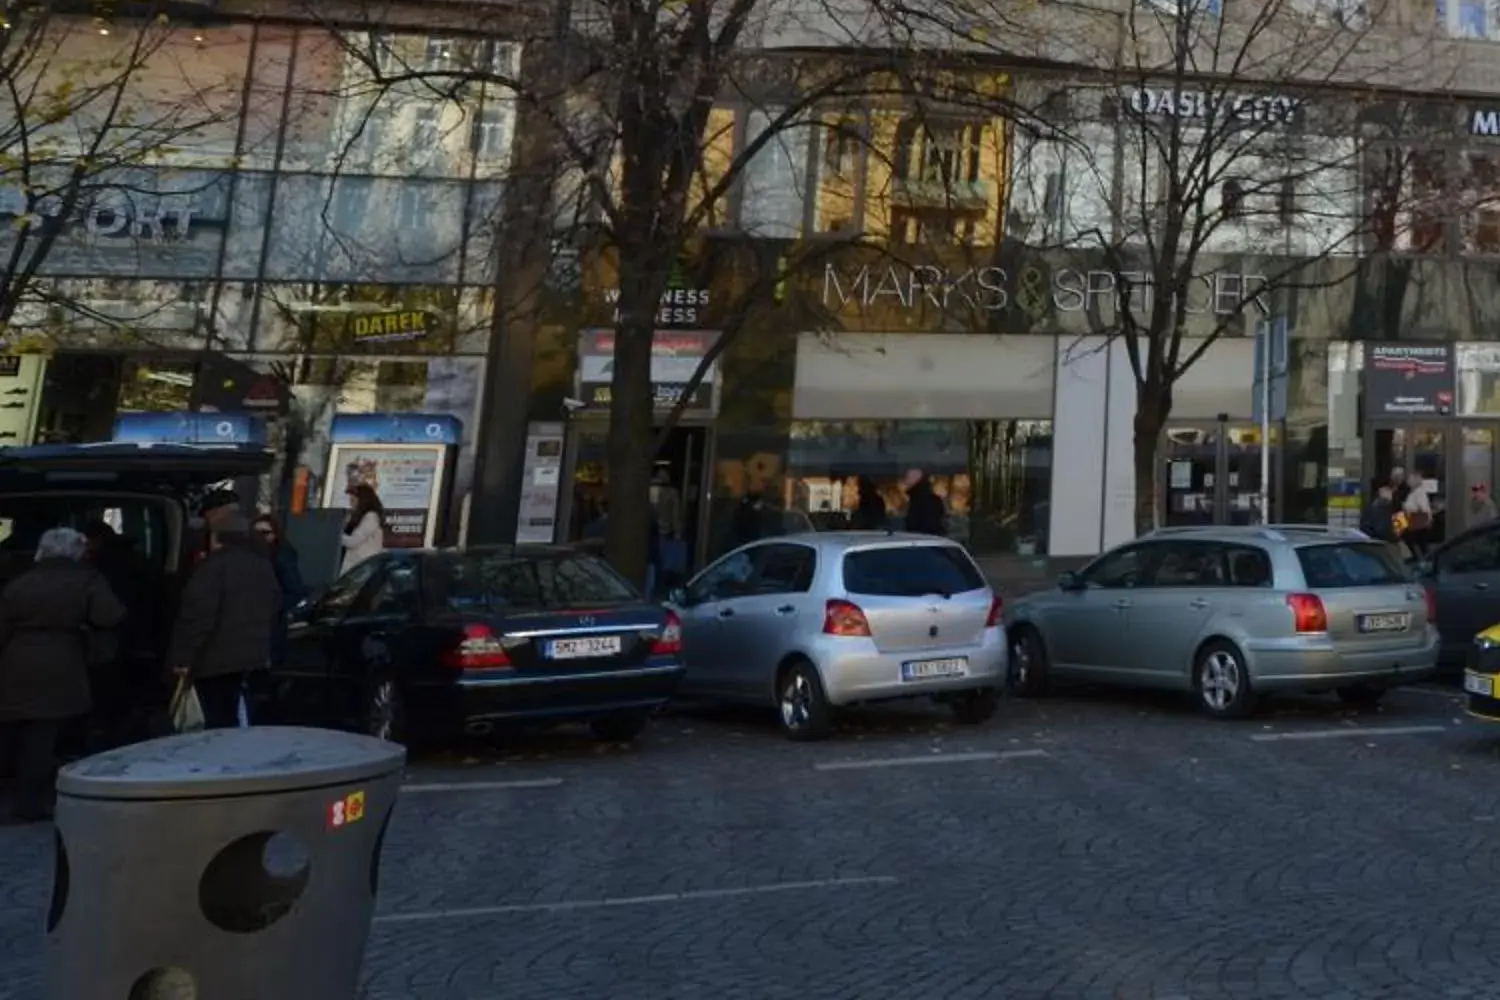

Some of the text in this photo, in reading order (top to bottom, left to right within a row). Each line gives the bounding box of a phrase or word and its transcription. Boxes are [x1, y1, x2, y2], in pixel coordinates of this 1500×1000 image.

[604, 288, 710, 304] WNESS
[822, 263, 1008, 309] MARKS
[355, 311, 425, 335] DAREK
